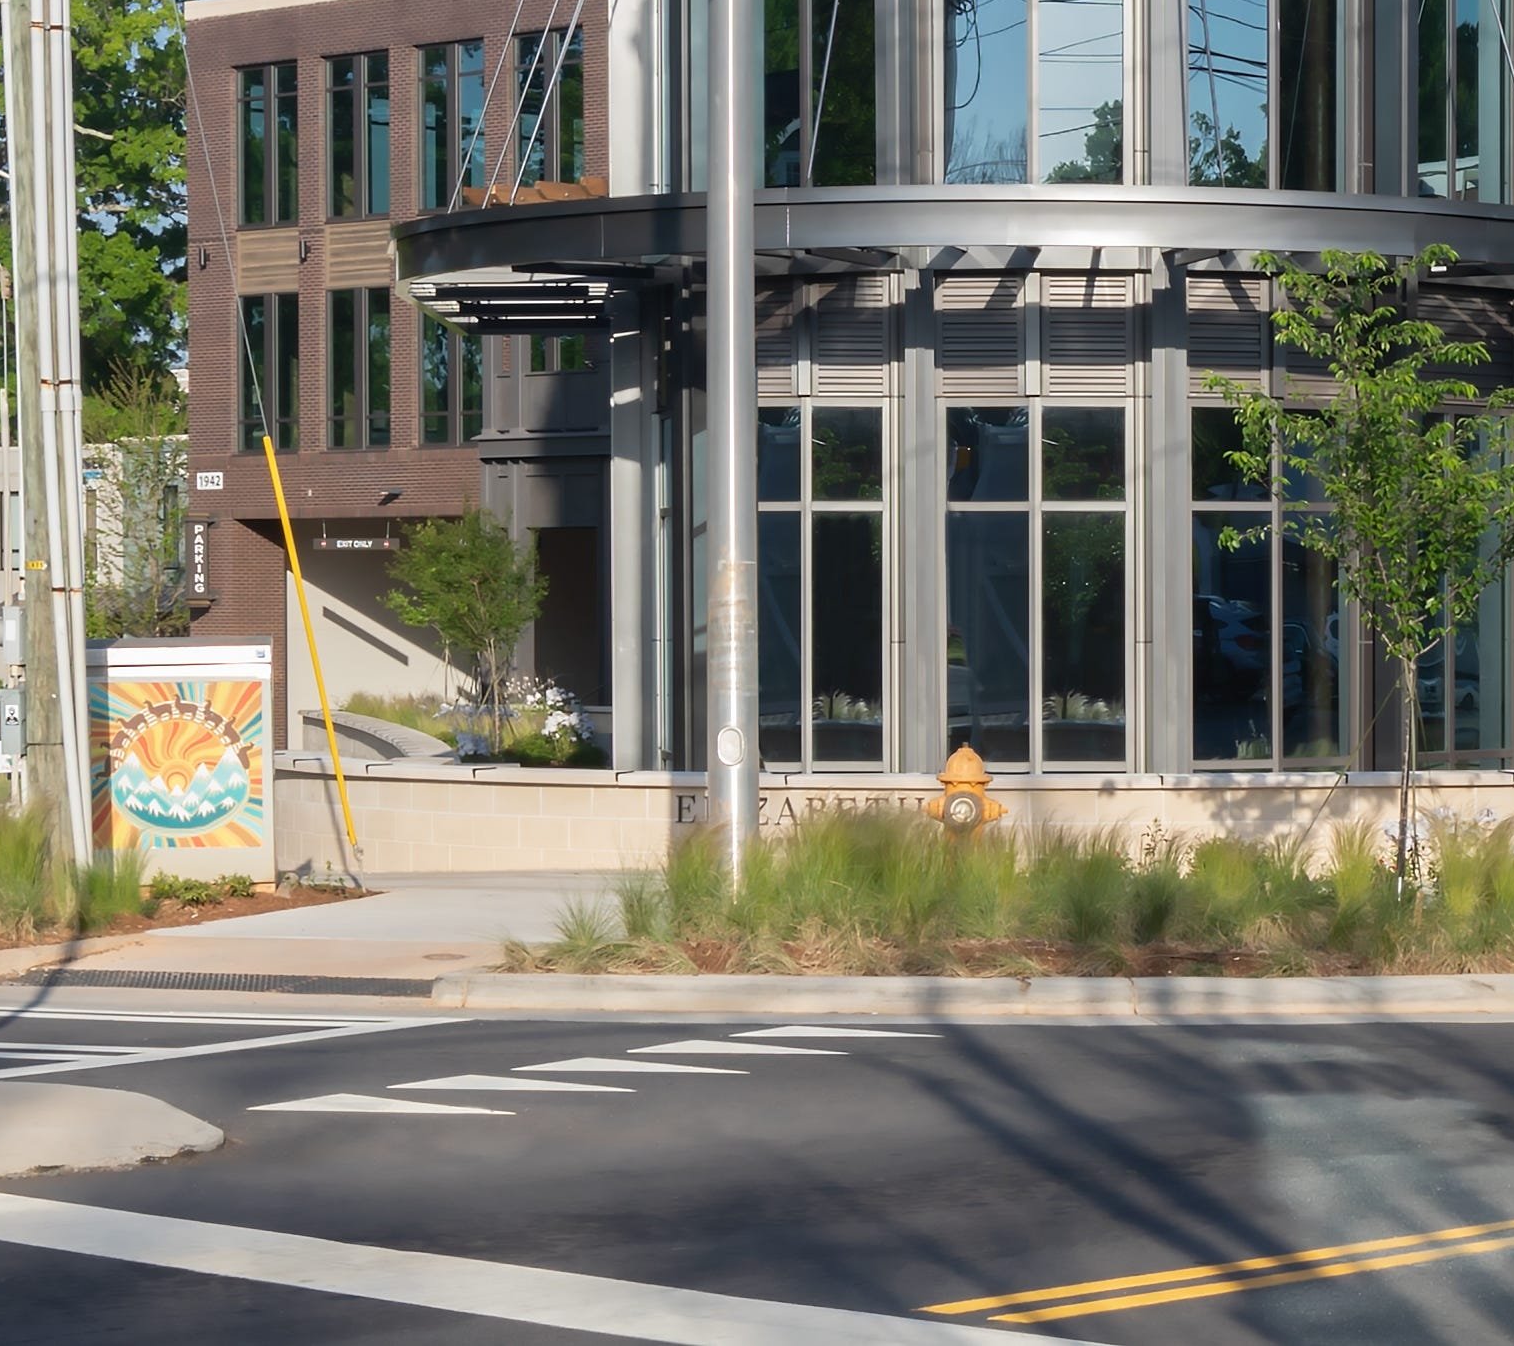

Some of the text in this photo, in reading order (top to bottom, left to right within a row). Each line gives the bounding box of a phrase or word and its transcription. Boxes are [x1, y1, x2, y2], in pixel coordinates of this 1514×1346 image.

[198, 474, 222, 487] 1942
[336, 540, 373, 548] EXIT ONLY
[193, 524, 205, 593] PARKING
